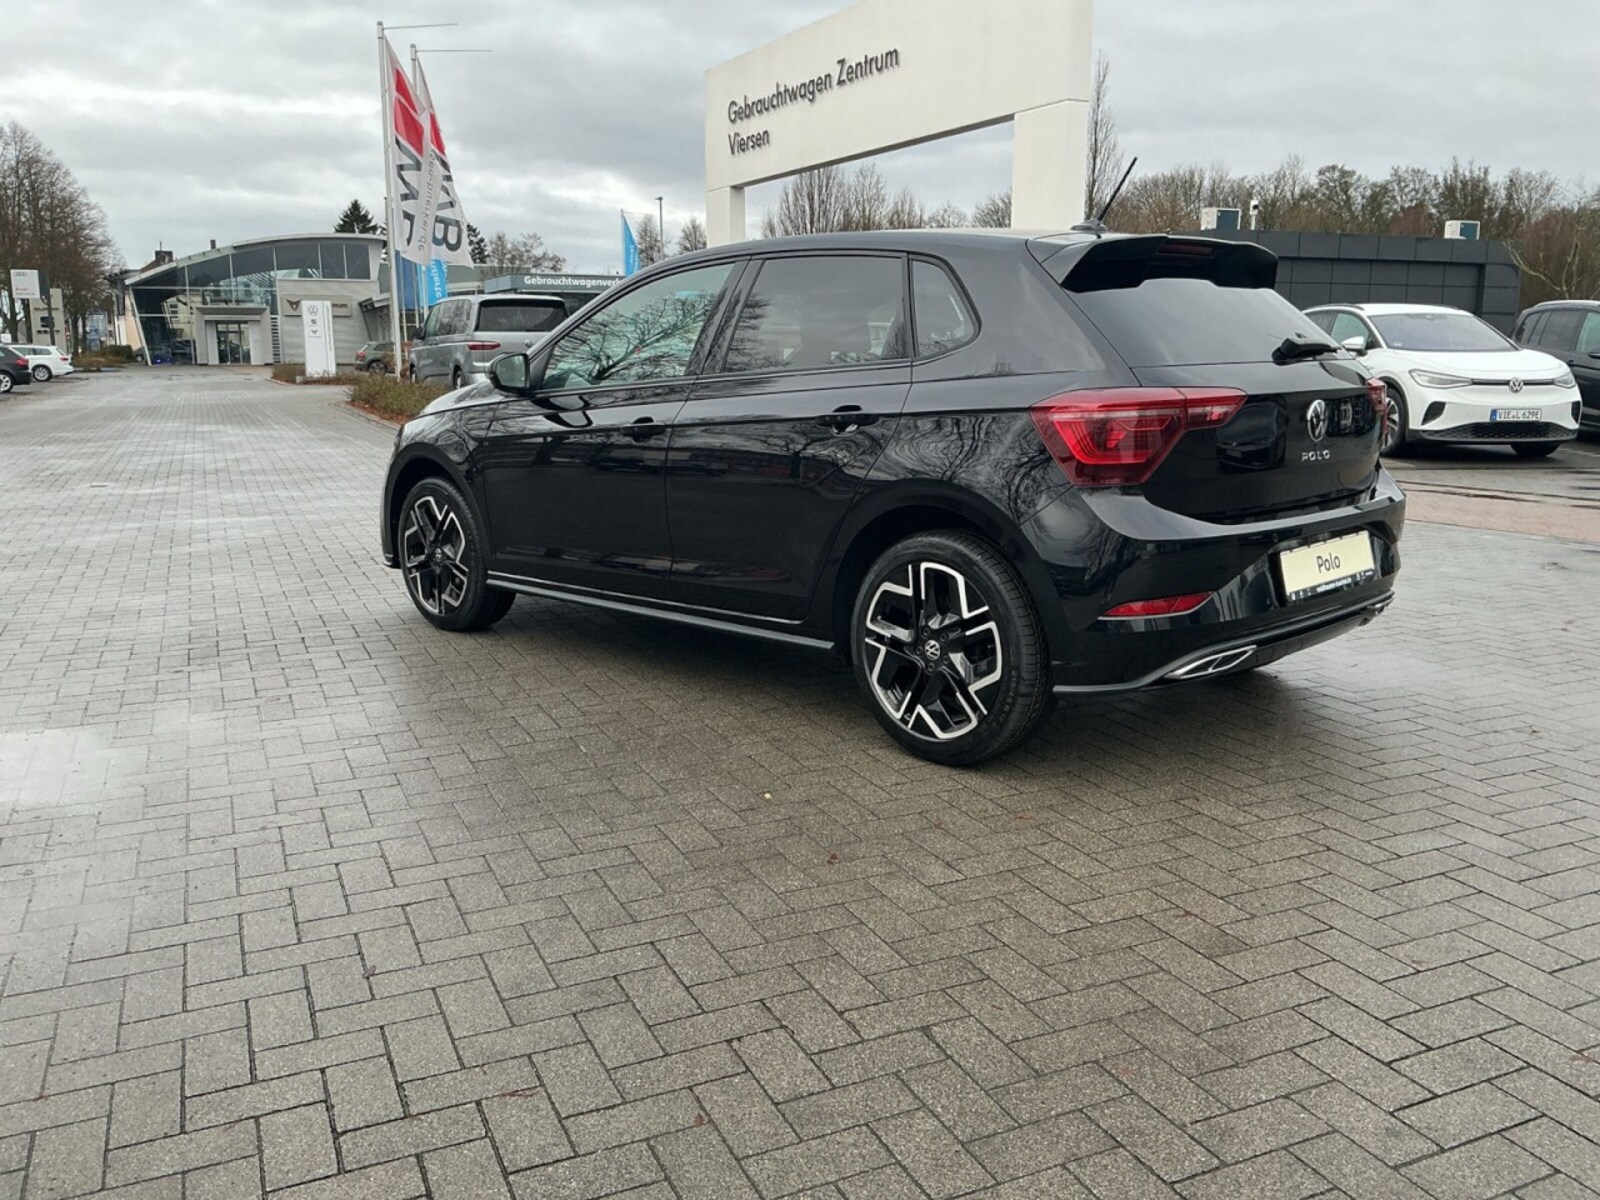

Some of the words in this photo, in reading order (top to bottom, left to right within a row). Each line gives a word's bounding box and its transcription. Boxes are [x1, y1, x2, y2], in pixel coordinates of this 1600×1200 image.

[728, 73, 832, 124] Gebrauchtwagen
[836, 48, 899, 86] Zentrum
[728, 130, 770, 156] Viersen
[1301, 450, 1330, 462] POLO
[1316, 552, 1341, 573] Polo
